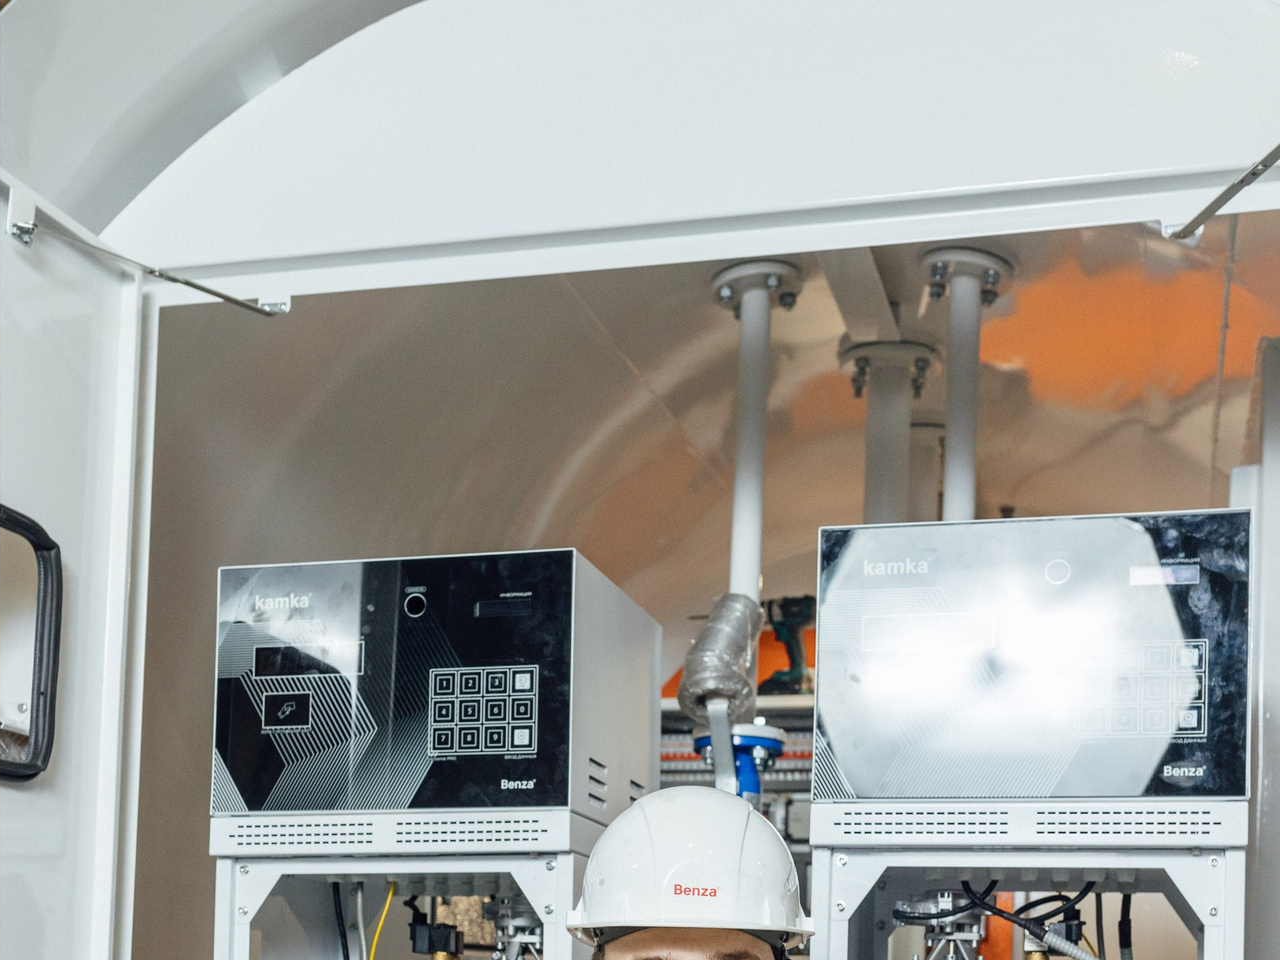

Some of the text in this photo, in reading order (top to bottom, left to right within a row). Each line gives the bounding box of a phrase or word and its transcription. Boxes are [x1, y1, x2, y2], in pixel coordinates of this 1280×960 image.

[863, 557, 929, 576] kamka
[254, 593, 310, 611] kamka
[1163, 765, 1205, 777] Benza
[500, 779, 535, 790] Benza
[673, 883, 718, 898] Benza
